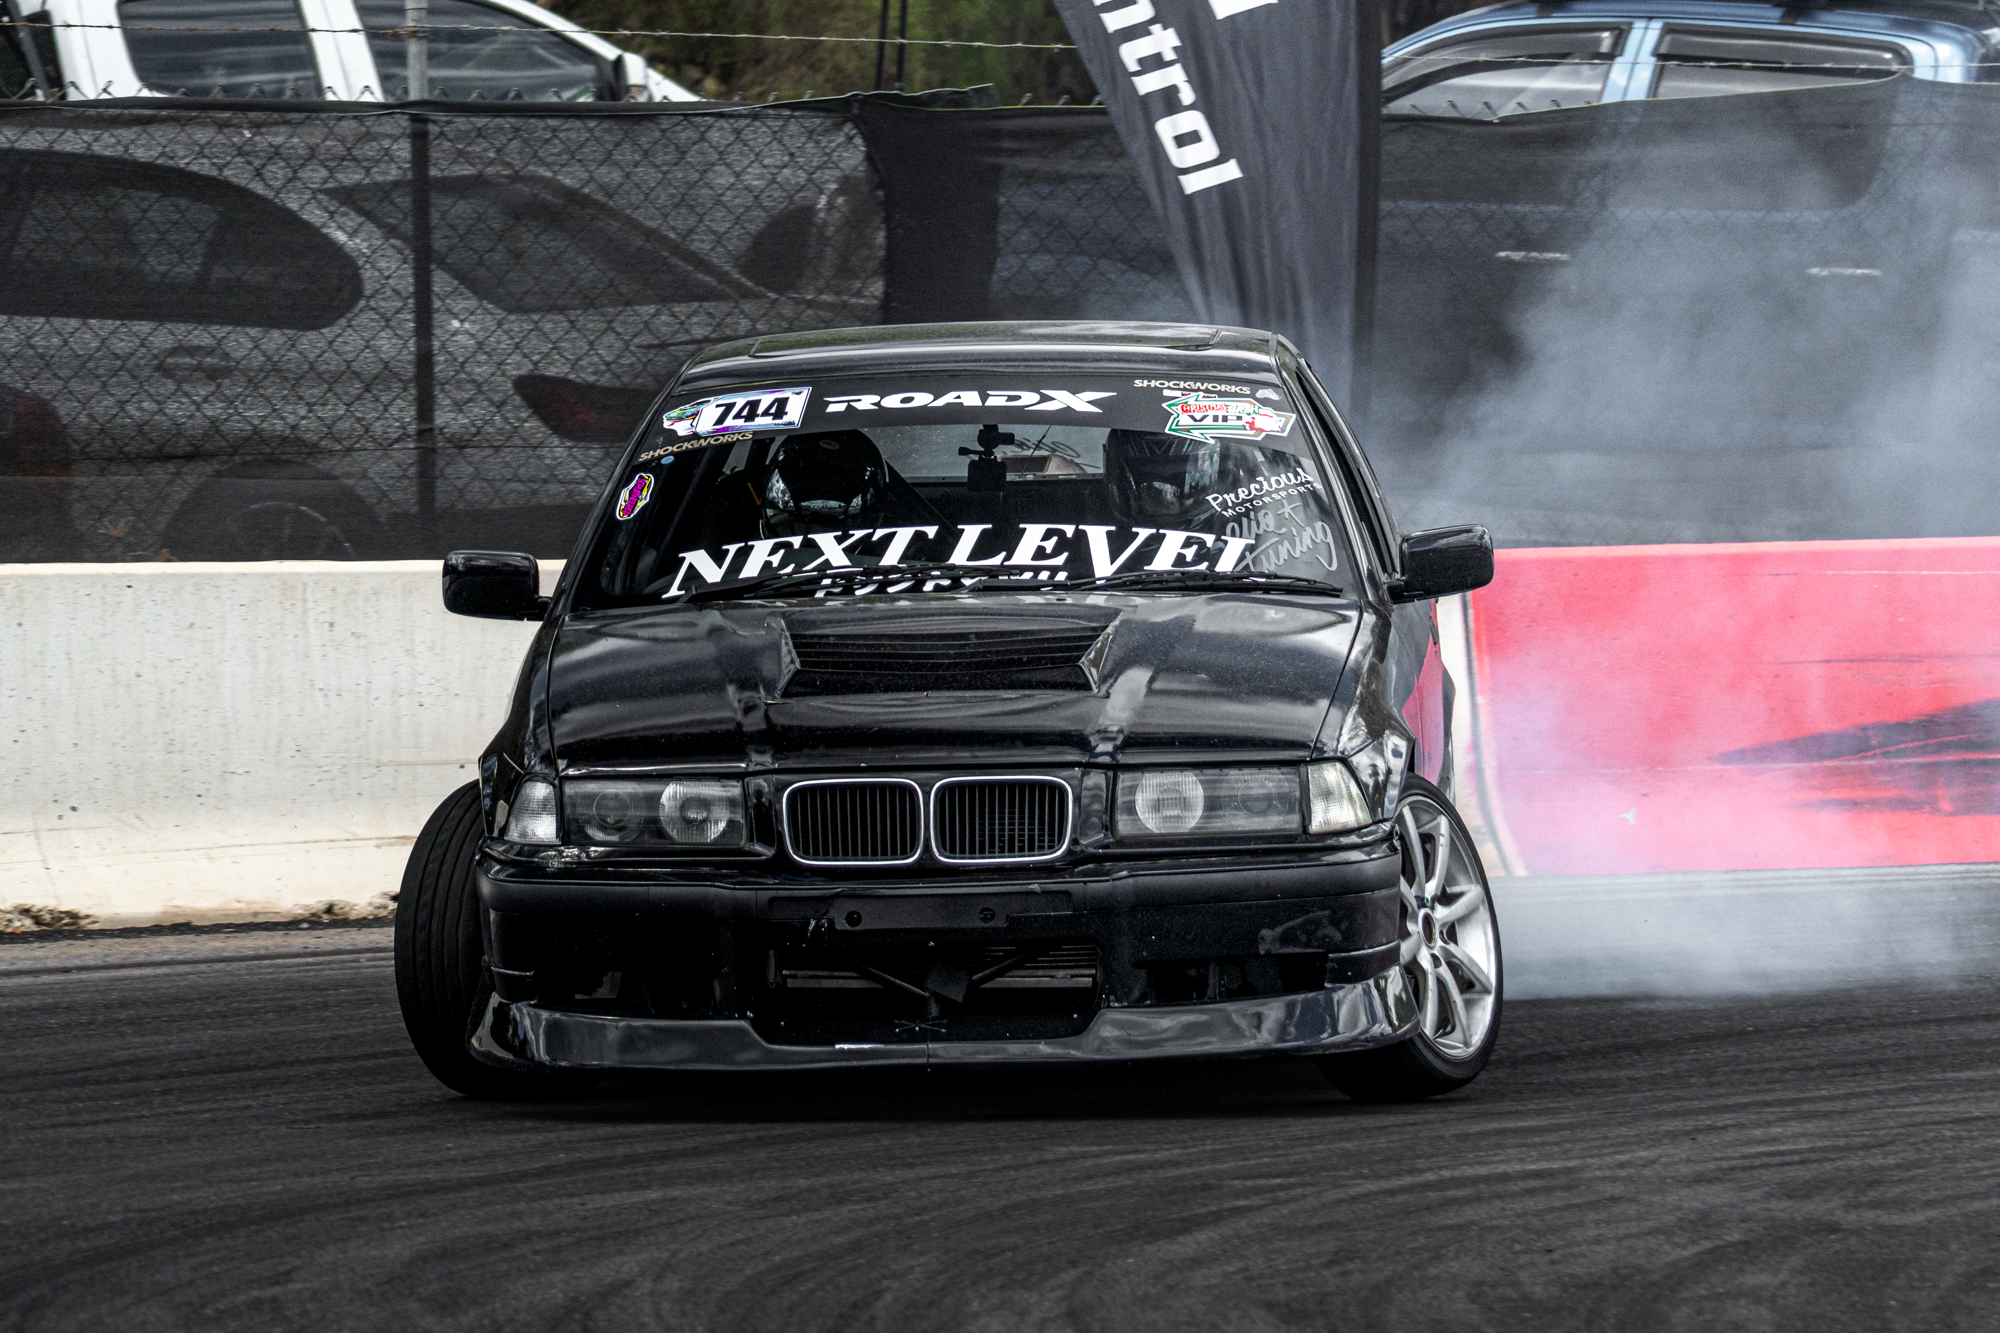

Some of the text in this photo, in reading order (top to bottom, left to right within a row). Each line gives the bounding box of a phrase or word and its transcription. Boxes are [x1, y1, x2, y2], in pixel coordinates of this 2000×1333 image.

[823, 389, 1118, 413] ROADX
[1133, 379, 1251, 395] SHOCKWORKS
[712, 396, 790, 426] 744
[1187, 414, 1243, 423] VIP
[638, 431, 754, 462] SHOCKWORKS
[1205, 467, 1314, 512] Precious
[1220, 482, 1323, 518] MOTORSPORTS
[661, 524, 939, 598] NEXT
